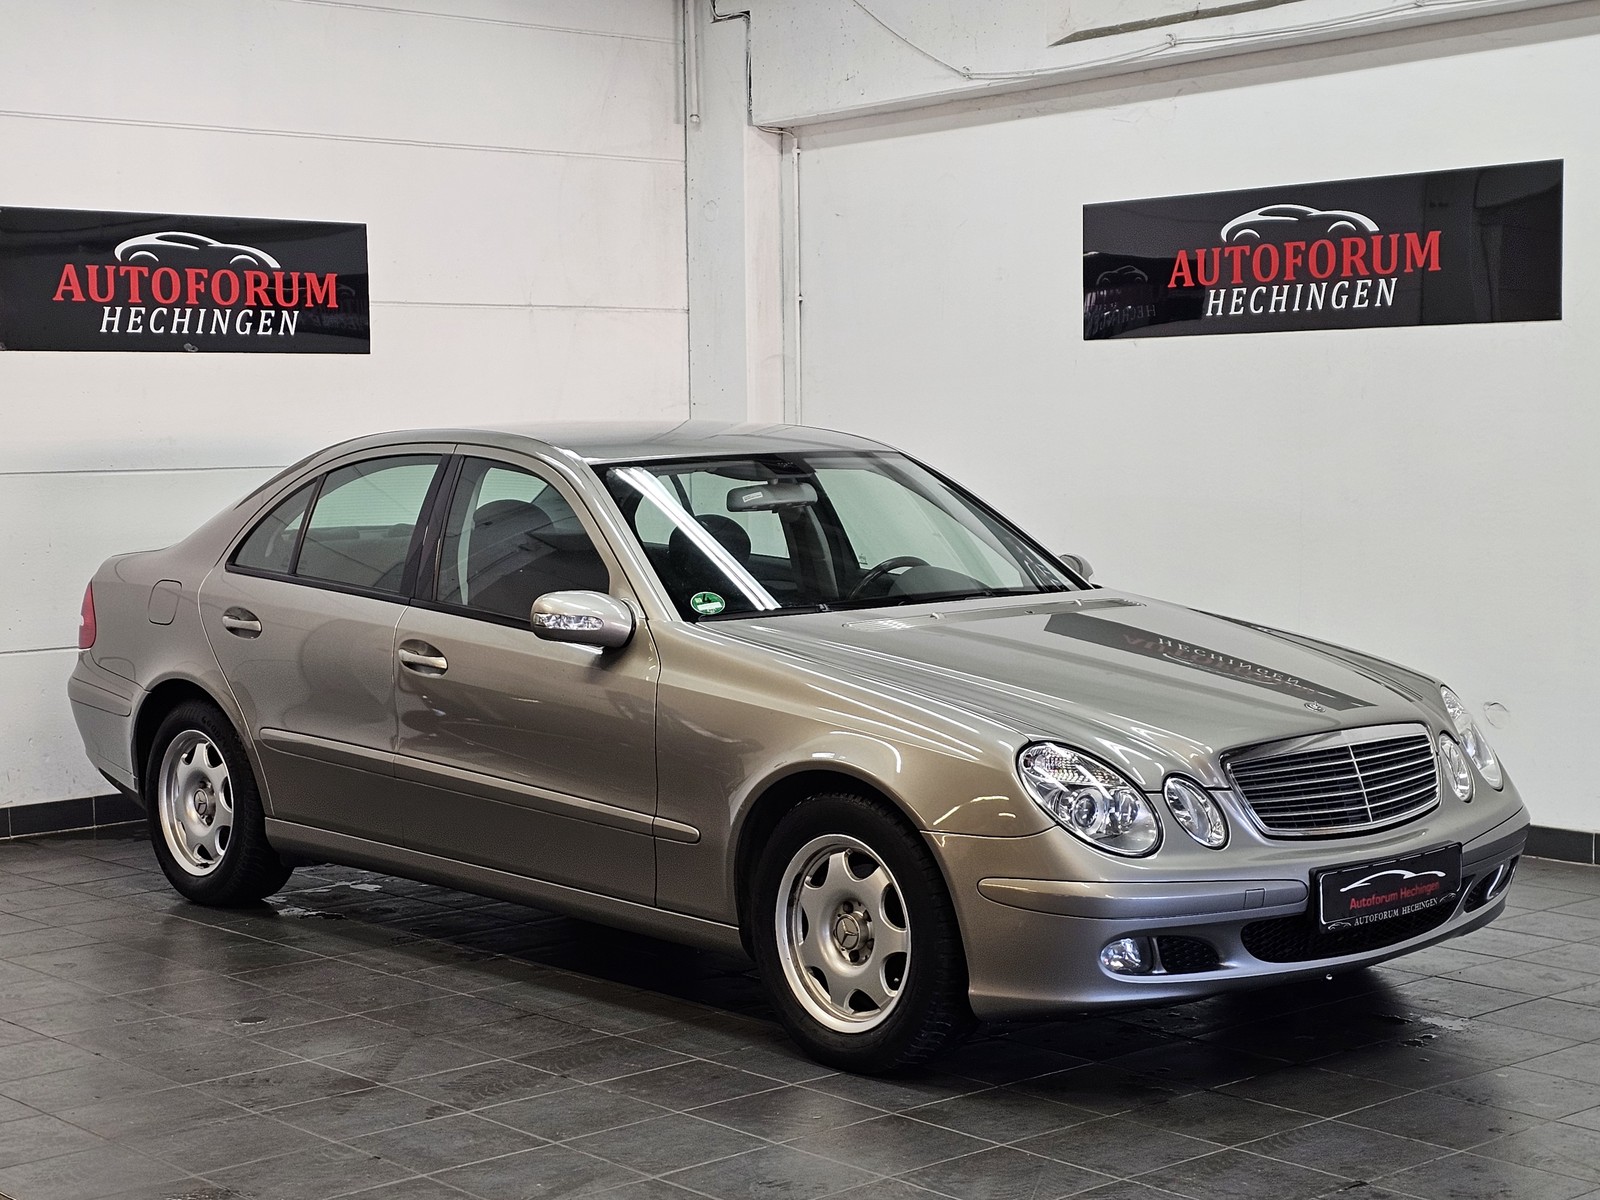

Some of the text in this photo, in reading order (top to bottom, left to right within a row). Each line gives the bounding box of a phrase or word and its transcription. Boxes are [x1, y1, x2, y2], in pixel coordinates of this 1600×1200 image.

[1168, 231, 1440, 288] AUTOFORUM
[53, 263, 339, 309] AUTOFORUM
[1205, 277, 1398, 318] HECHINGEN
[99, 306, 300, 336] HECHINGEN
[1349, 881, 1441, 911] Autoforum Hechingen
[1353, 897, 1439, 927] AUTOFORUM HECHINGEN
